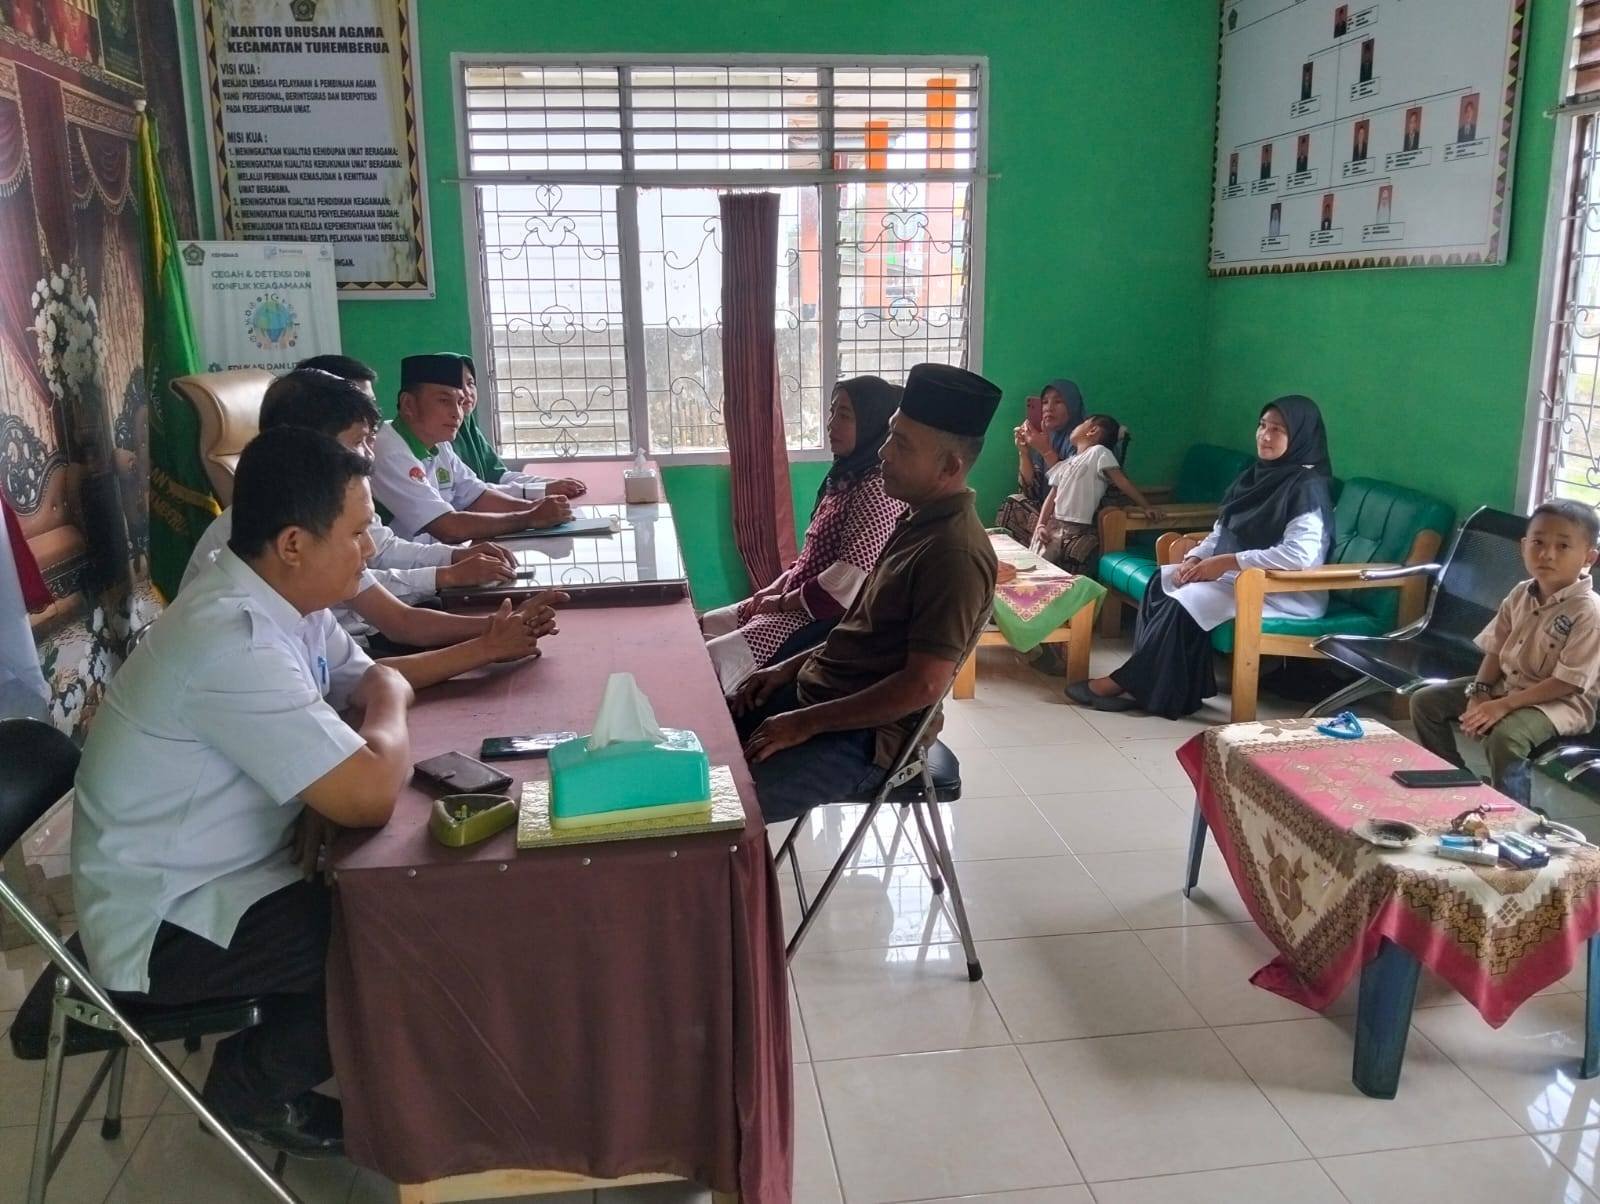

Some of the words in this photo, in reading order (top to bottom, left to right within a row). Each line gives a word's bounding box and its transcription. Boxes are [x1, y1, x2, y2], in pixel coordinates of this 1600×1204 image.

[231, 26, 281, 37] KANTOR
[285, 26, 336, 38] URUSAN
[339, 26, 384, 38] AGAMA
[228, 42, 302, 53] KECAMATAN
[305, 42, 389, 53] TUHEMBERUA
[220, 64, 236, 74] VISI
[239, 64, 256, 74] KUA
[328, 92, 339, 100] DAN
[341, 92, 377, 100] BERPOTENSI
[243, 105, 292, 113] KESEJAHTERAAN
[227, 132, 244, 143] MISI
[246, 132, 262, 143] KUA
[283, 147, 311, 155] KUALITAS
[347, 147, 363, 155] UMAT
[284, 160, 313, 168] KUALITAS
[351, 160, 367, 168] UMAT
[288, 198, 316, 206] KUALITAS
[289, 210, 317, 218] KUALITAS
[285, 222, 299, 231] TATA
[301, 222, 323, 231] KELOLA
[378, 222, 393, 231] YANG
[364, 234, 379, 242] YANG
[211, 270, 244, 279] CEGAH
[255, 270, 292, 278] DETEKSI
[212, 282, 251, 290] KONFLIK
[253, 282, 312, 290] KEAGAMAAN
